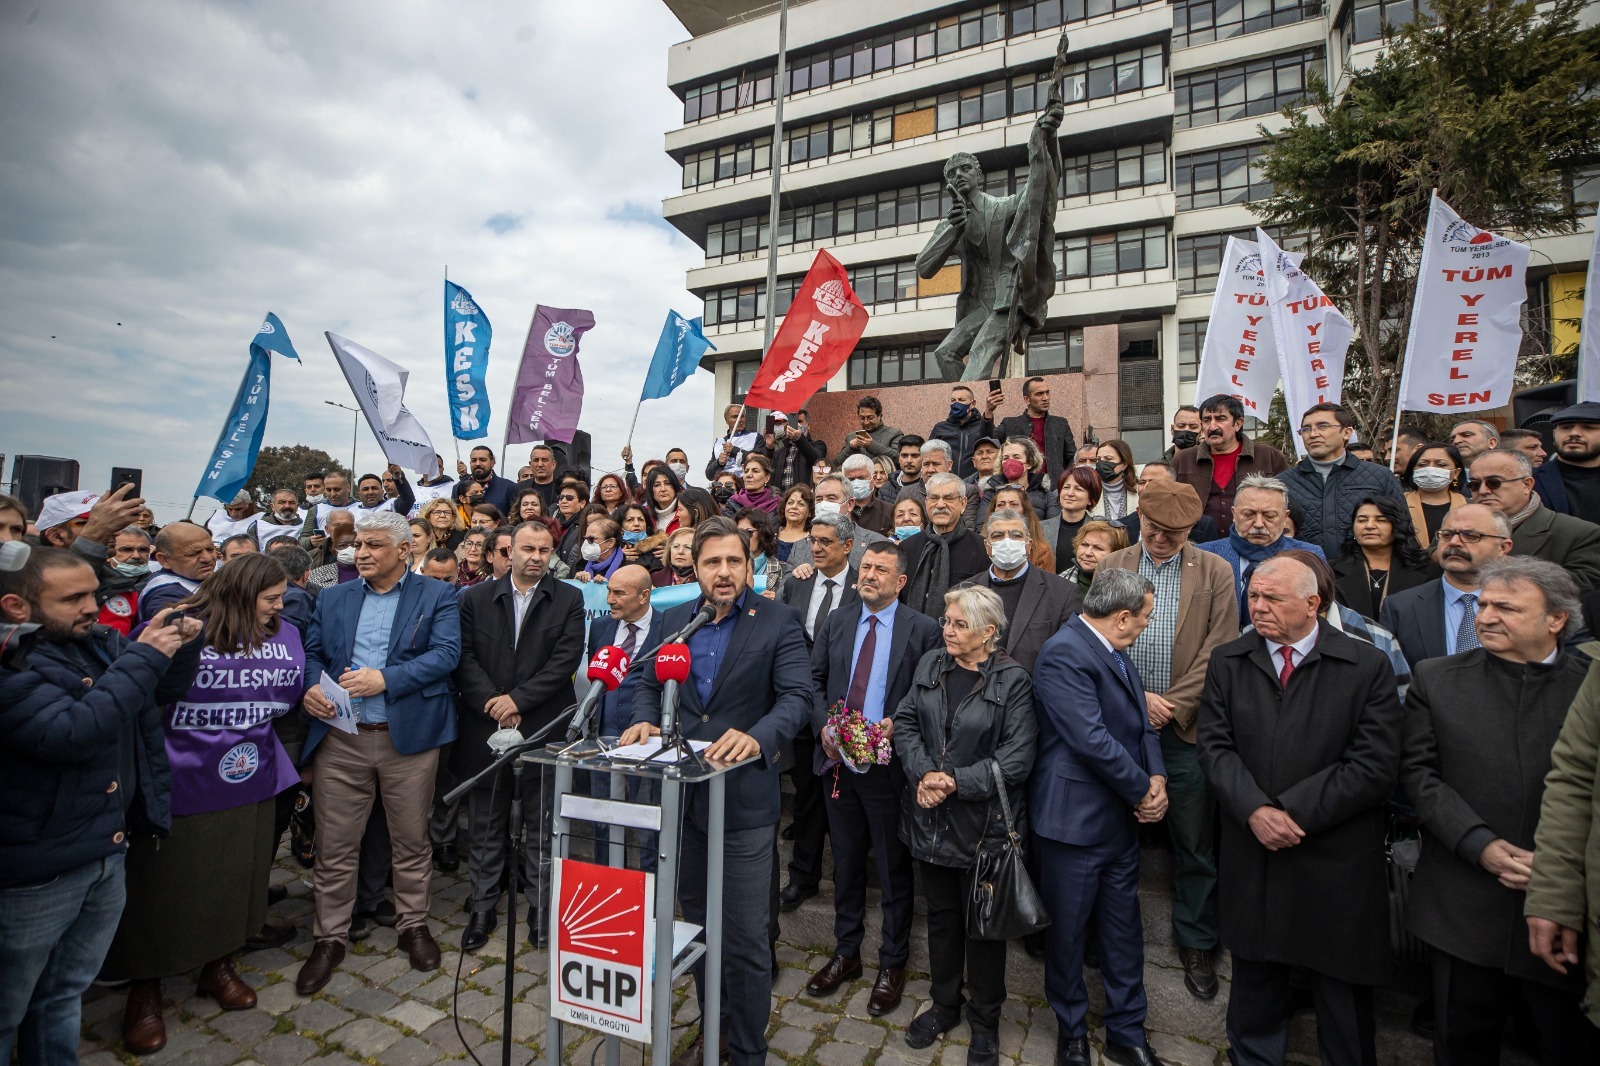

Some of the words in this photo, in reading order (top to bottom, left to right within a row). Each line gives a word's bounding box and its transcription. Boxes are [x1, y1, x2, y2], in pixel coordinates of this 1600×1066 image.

[1469, 240, 1511, 252] YEREL-SEN
[1442, 264, 1513, 283] TÜM
[812, 287, 856, 317] KESK
[1234, 292, 1270, 306] TÜ
[1231, 315, 1264, 387] YEREL
[1449, 293, 1486, 380] YEREL
[768, 319, 831, 393] KESK
[1307, 322, 1332, 405] YEREL
[246, 374, 265, 405] TÜM
[453, 320, 480, 432] KESK
[1426, 390, 1492, 406] SEN
[657, 655, 686, 663] DHA
[192, 664, 300, 690] ÖZLEŞMESİ
[561, 961, 637, 1008] CHP
[571, 1009, 589, 1022] İZMİR
[591, 1013, 598, 1024] İL
[598, 1015, 630, 1033] ÖRGÜTÜ
